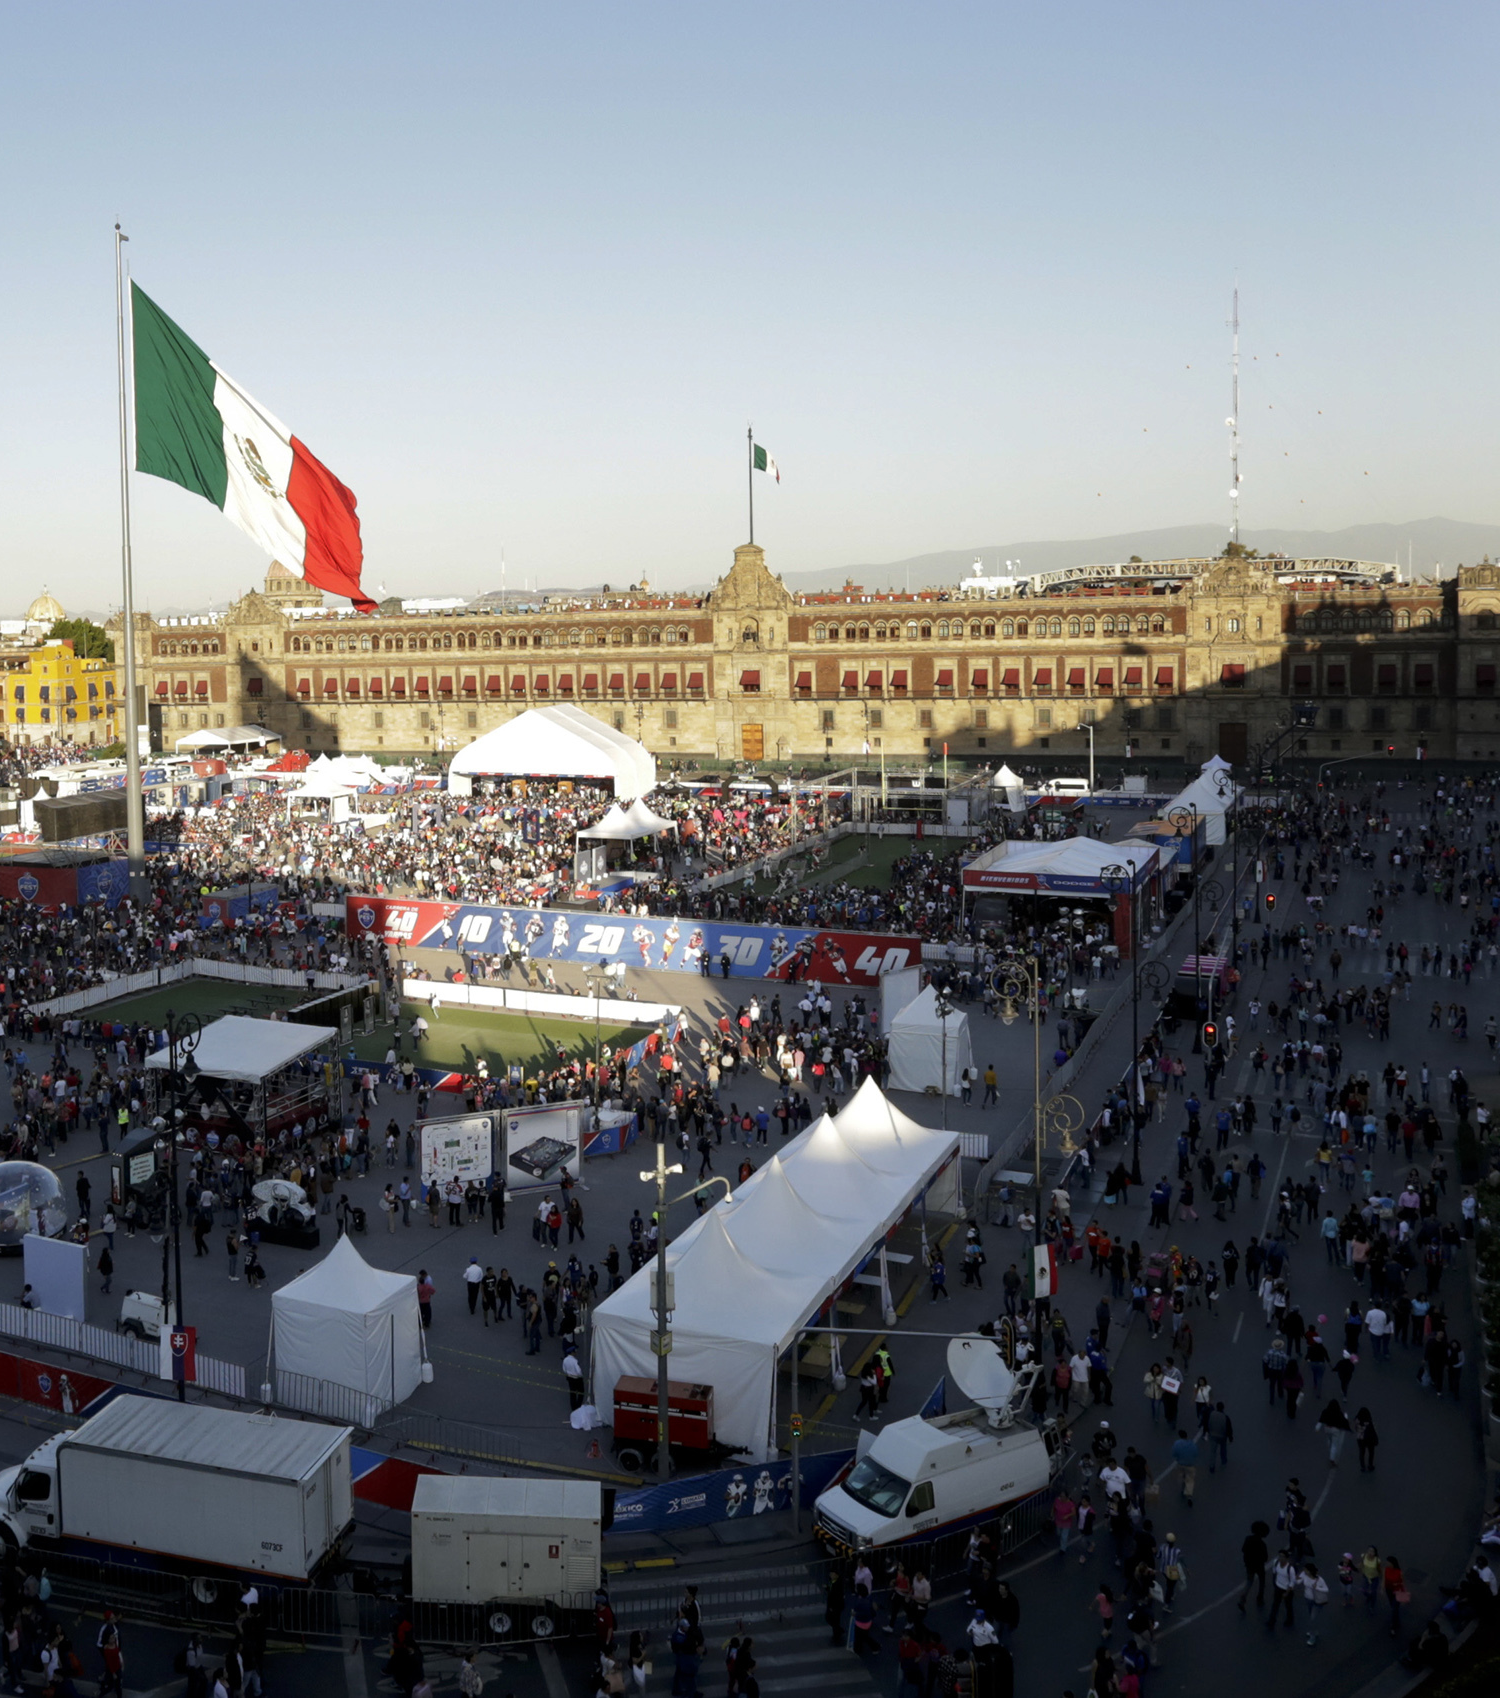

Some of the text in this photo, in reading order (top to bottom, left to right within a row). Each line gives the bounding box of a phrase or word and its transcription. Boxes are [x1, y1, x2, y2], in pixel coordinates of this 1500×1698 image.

[979, 875, 1029, 884] BIENVENIDOS
[385, 910, 418, 932] 40
[457, 914, 492, 943] 10
[384, 930, 413, 940] YARDAS
[576, 924, 625, 955] 20
[712, 934, 764, 967] 30
[854, 945, 910, 977] 40
[261, 1541, 283, 1552] 6073CF
